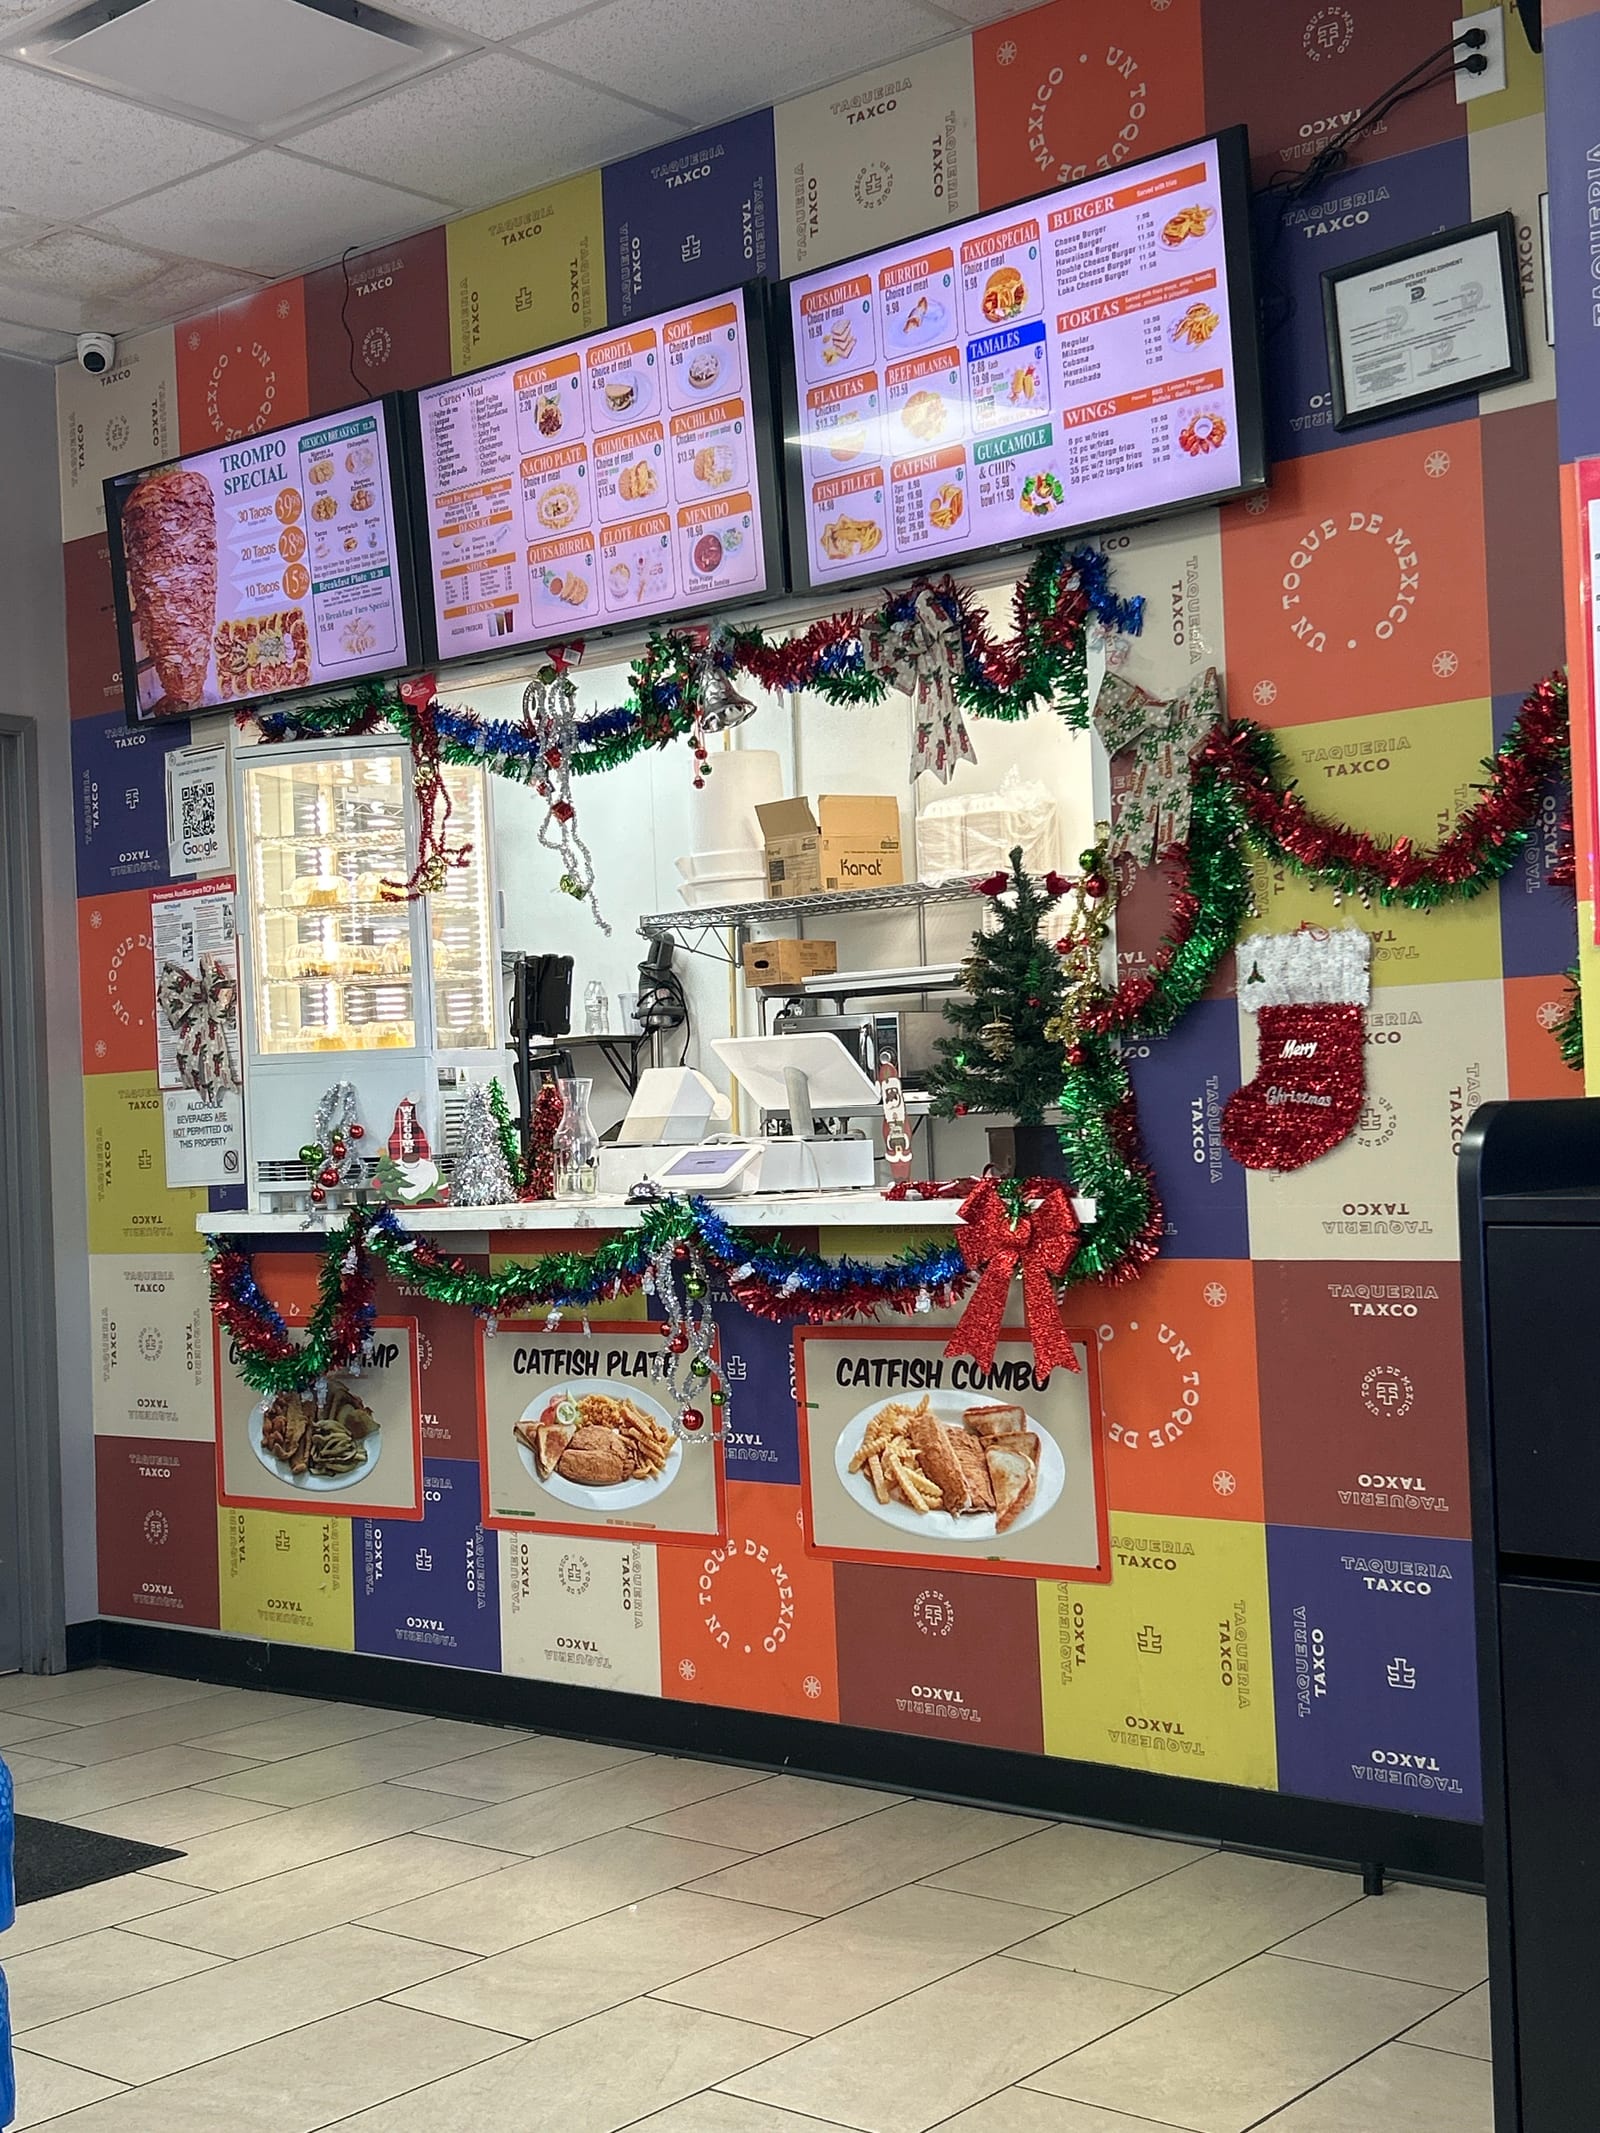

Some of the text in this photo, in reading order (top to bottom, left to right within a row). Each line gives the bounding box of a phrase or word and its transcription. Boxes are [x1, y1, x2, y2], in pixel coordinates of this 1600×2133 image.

[830, 77, 912, 115] TAQUERIA
[847, 100, 897, 125] TAXCO
[1028, 46, 1147, 183] UN TOQUE DE MEXICO
[651, 144, 725, 179] TAQUERIA
[932, 135, 943, 198] TAXCO
[665, 164, 711, 190] TAXCO
[1053, 197, 1114, 229] BURGER
[1282, 186, 1390, 226] TAQUERIA
[501, 224, 542, 247] TAXCO
[1082, 225, 1107, 241] Burger
[1304, 210, 1369, 239] TAXCO
[962, 225, 1037, 262] TAXCO SPECIAL
[1078, 236, 1103, 252] Burger
[1095, 241, 1120, 256] Burger
[1111, 246, 1136, 260] Burger
[884, 260, 929, 288] BURRITO
[964, 262, 983, 276] Choice
[990, 255, 1005, 268] meat
[1107, 258, 1132, 273] Burger
[1521, 225, 1532, 299] TAXCO
[356, 276, 393, 297] TAXCO
[1104, 269, 1129, 283] Burger
[806, 284, 861, 310] QUESADILLA
[885, 286, 906, 300] Choice
[913, 279, 929, 292] meat
[1060, 301, 1120, 331] TORTAS
[667, 321, 693, 340] SOPE
[669, 338, 688, 353] Choice
[697, 332, 712, 346] meat
[590, 341, 633, 366] GORDITA
[969, 331, 1020, 358] TAMALES
[1061, 336, 1090, 350] Regular
[100, 369, 131, 388] TAXCO
[518, 368, 547, 388] TACOS
[888, 355, 953, 382] BEEF MILANESA
[1064, 373, 1101, 388] Planchada
[207, 342, 270, 433] UN MEXICO
[813, 379, 864, 405] FLAUTAS
[674, 408, 726, 432] ENCHILADA
[815, 402, 841, 418] Chicken
[1066, 400, 1117, 425] WINGS
[302, 435, 328, 448] MEXICAN
[594, 426, 660, 457] CHIMICHANGA
[977, 429, 1047, 461] GUACAMOLE
[220, 440, 286, 474] TROMPO
[522, 448, 582, 476] NACHO PLATE
[893, 454, 937, 478] CATFISH
[978, 459, 1016, 479] & CHIPS
[224, 463, 288, 496] SPECIAL
[817, 472, 876, 501] FISH FILLET
[238, 506, 272, 523] 30 Tacos
[685, 502, 729, 524] MENUDO
[603, 518, 666, 545] ELOTE CORN
[241, 543, 276, 561] 20 Tacos
[529, 536, 590, 563] QUESABIRRIA
[245, 581, 280, 598] 10 Tacos
[319, 577, 349, 591] Breakfast
[1282, 511, 1419, 653] UN TOQUE DE MEXICO
[325, 608, 353, 620] Breakfast
[369, 600, 390, 612] Special
[1171, 579, 1185, 646] TAXCO
[114, 735, 146, 749] TAXCO
[1301, 736, 1411, 763] TAQUERIA
[1323, 758, 1390, 778] TAXCO
[119, 850, 150, 862] TAXCO
[182, 838, 218, 859] Google
[840, 858, 882, 876] Karat
[108, 935, 134, 995] TOQUE
[1279, 1039, 1318, 1059] Merry
[187, 1099, 223, 1111] ALCOHOLIC
[1264, 1086, 1332, 1107] Christmas
[177, 1112, 228, 1124] BEVERAGES ARE
[400, 1105, 415, 1154] WELCOME
[1206, 1075, 1223, 1184] TAQUERIA
[173, 1123, 233, 1138] NOT PERMITTED ON
[1191, 1097, 1205, 1164] TAXCO
[179, 1137, 227, 1149] THIS PROPERTY
[1342, 1203, 1410, 1216] TAXCO
[1322, 1220, 1433, 1234] TAQUERIA
[134, 1283, 165, 1293] TAXCO
[1328, 1283, 1439, 1300] TAQUERIA
[1349, 1303, 1418, 1318] TAXCO
[513, 1347, 599, 1377] CATFISH
[836, 1358, 941, 1390] CATFISH
[1108, 1323, 1200, 1449] UN TOQUE DE
[1361, 1365, 1415, 1417] UN TOQUE DE MEXICO
[1358, 1474, 1426, 1491] TAXCO
[1337, 1490, 1449, 1512] TAQUERIA
[1111, 1536, 1195, 1556] AQUERIA
[466, 1538, 475, 1591] TAXCO
[1117, 1553, 1177, 1571] TAXCO
[1341, 1556, 1452, 1580] TAQUERIA
[699, 1538, 795, 1653] UN TOQUE DE MEXICO
[1363, 1577, 1432, 1596] TAXCO
[406, 1616, 445, 1631] TAXCO
[1058, 1582, 1072, 1686] TAQUERIA
[1073, 1602, 1086, 1666] TAXCO
[557, 1637, 598, 1652] TAXCO
[1219, 1619, 1233, 1687] TAXCO
[1234, 1599, 1251, 1709] TAQUERIA
[1293, 1605, 1311, 1717] TAQUERIA
[1311, 1628, 1327, 1698] TAXCO
[911, 1685, 964, 1703] TAXCO
[895, 1698, 982, 1723] TAQUERIA
[1125, 1715, 1185, 1735] TAXCO
[1107, 1729, 1205, 1756] TAQUERIA
[1371, 1749, 1440, 1771] TAXCO
[1351, 1764, 1463, 1794] TAQUERIA
